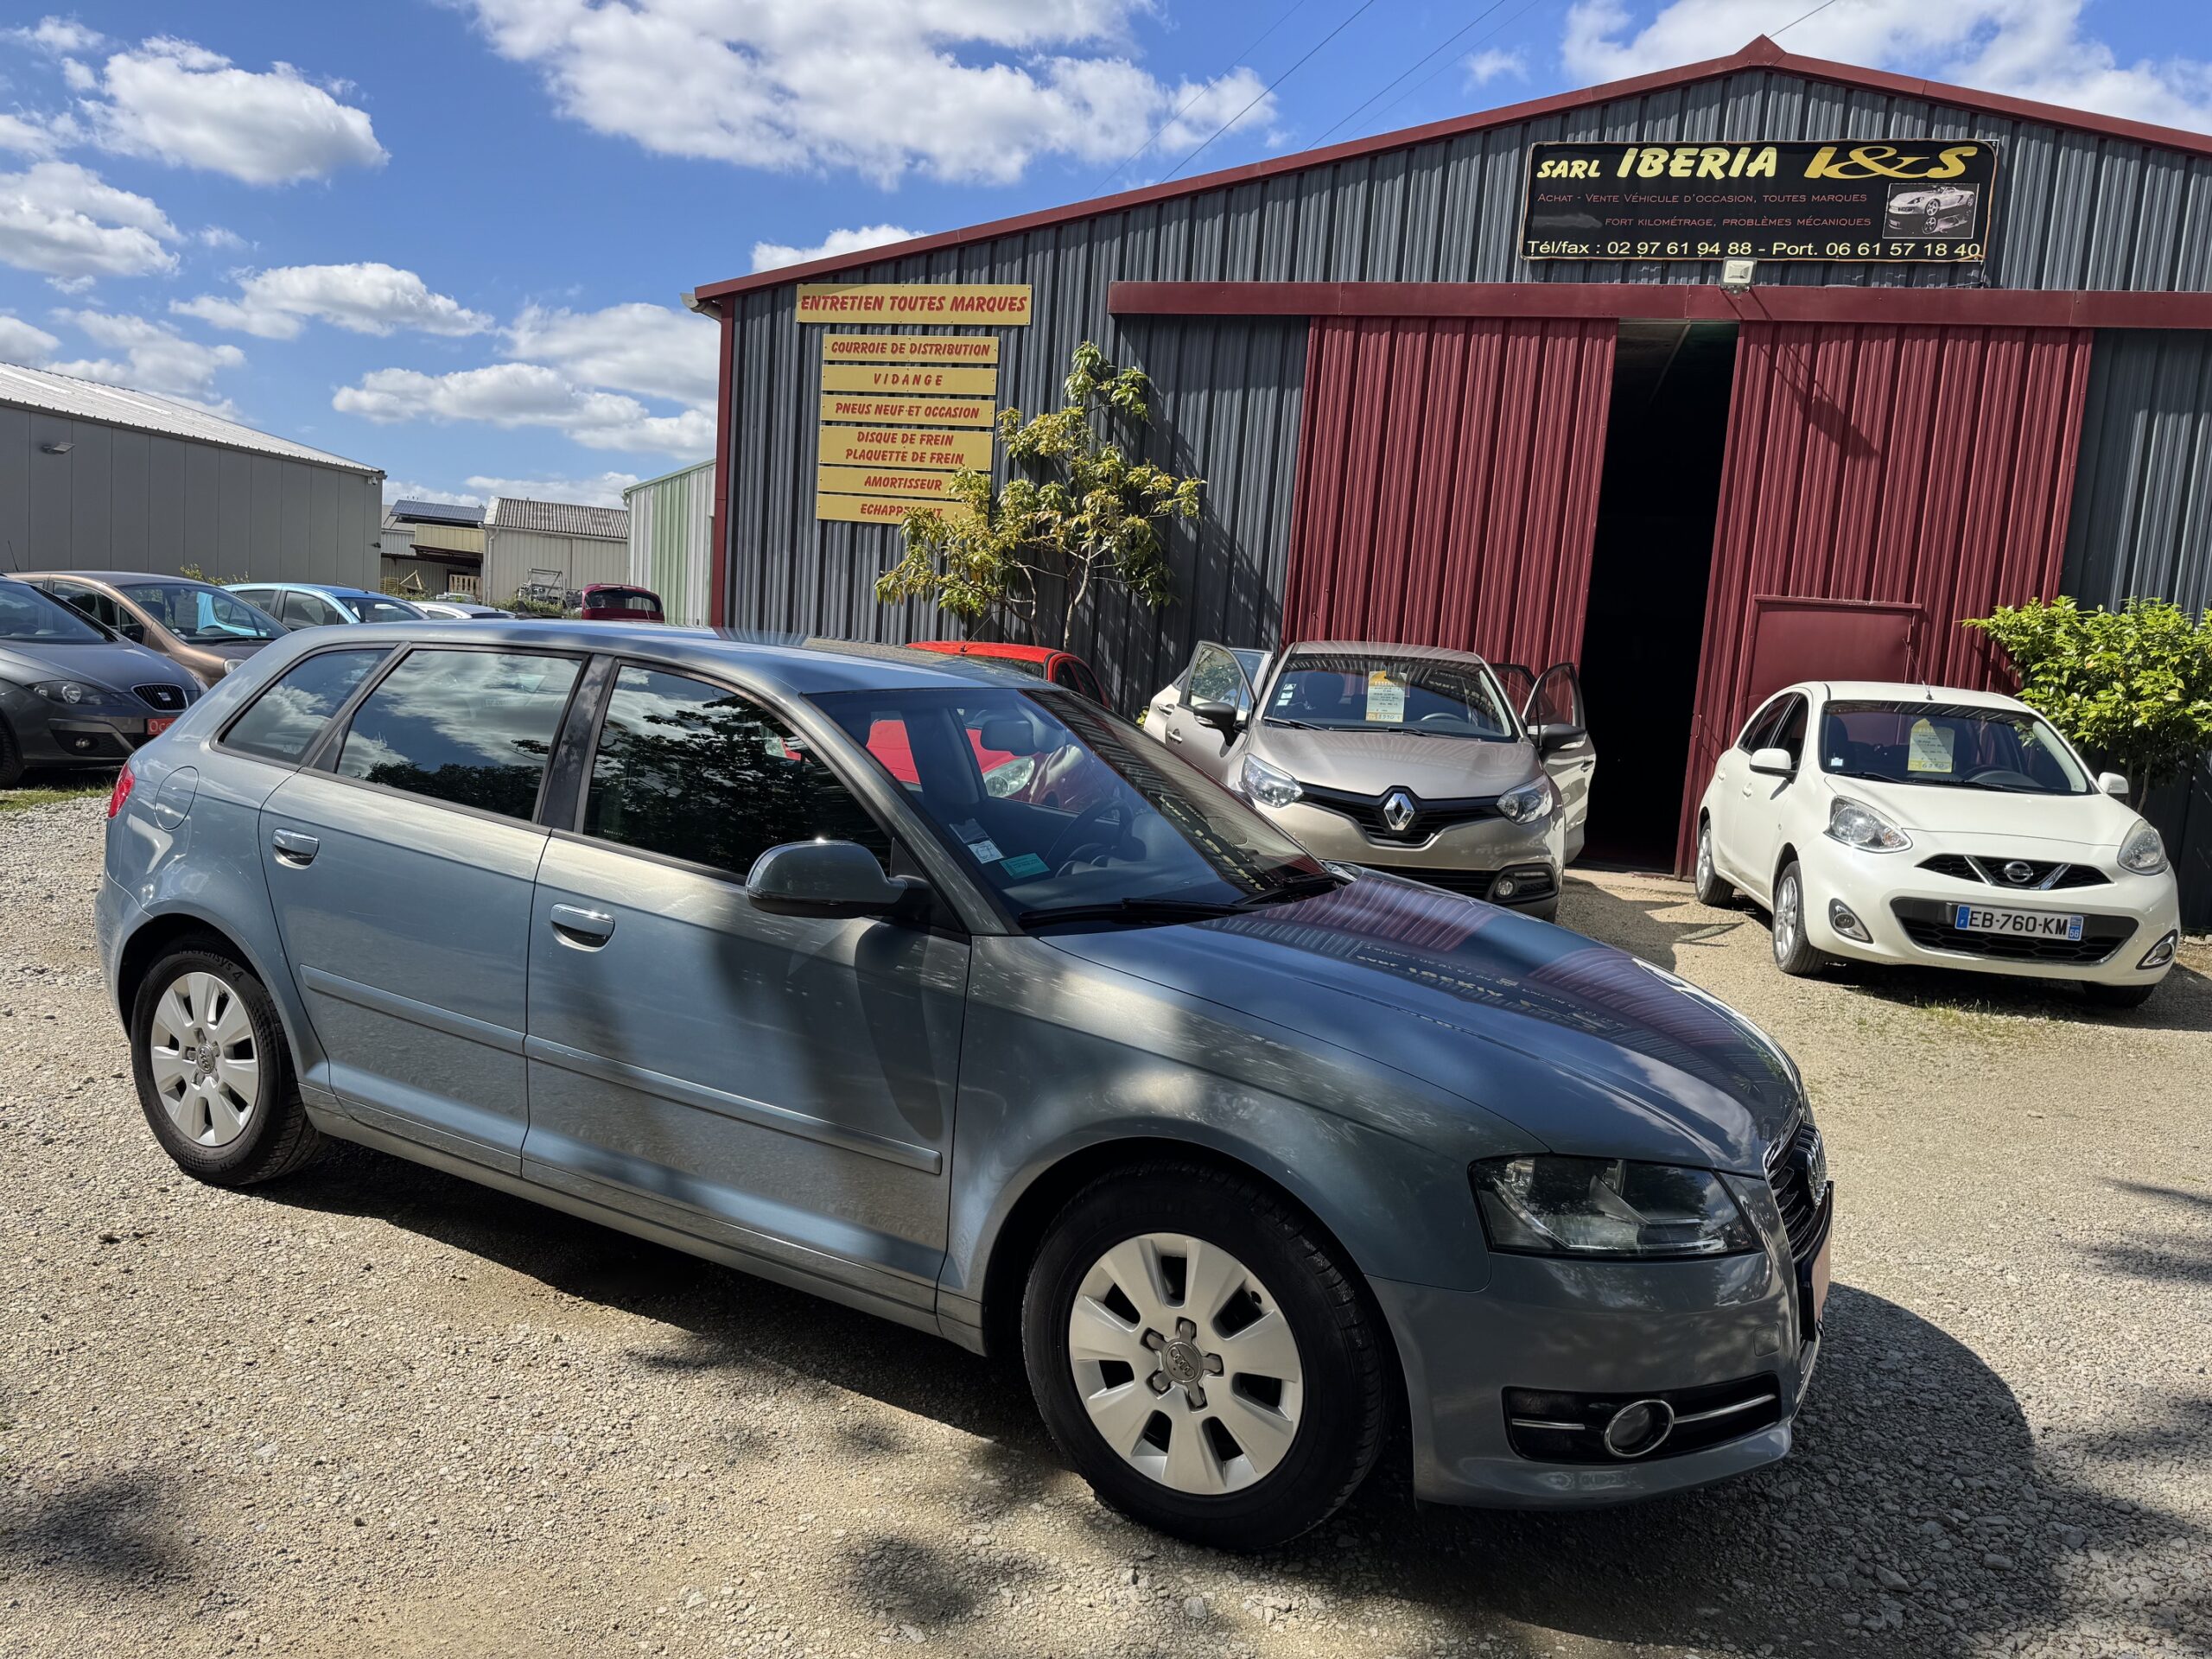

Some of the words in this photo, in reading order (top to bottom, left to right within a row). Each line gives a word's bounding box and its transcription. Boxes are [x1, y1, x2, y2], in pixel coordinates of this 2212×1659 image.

[1536, 160, 1601, 179] SARL
[1617, 147, 1777, 180] IBERIA
[1803, 145, 1978, 179] I&S
[1537, 194, 1573, 202] ACHAT
[1586, 194, 1619, 203] VENTE
[1624, 192, 1679, 203] VÉHICULE
[1605, 218, 1634, 226] FORT
[1637, 216, 1717, 227] KILOMÉTRAGE,
[1722, 215, 1792, 226] PROBLÈMES
[1796, 215, 1872, 226] MÉCANIQUES
[1527, 240, 1590, 254] Tél/fax
[1607, 241, 1630, 254] 02
[1637, 242, 1661, 254] 97
[1666, 242, 1688, 255] 61
[1697, 242, 1720, 255] 94
[1727, 242, 1751, 255] 88
[1772, 242, 1818, 256] Port.
[1826, 242, 1851, 256] 06
[1858, 242, 1880, 256] 61
[1890, 243, 1916, 256] 57
[1923, 243, 1948, 256] 18
[1954, 243, 1980, 257] 40
[801, 296, 885, 311] ENTRETIEN
[889, 296, 946, 312] TOUTES
[950, 296, 1027, 313] MARQUES
[831, 341, 887, 354] COURROIE
[891, 342, 906, 354] DE
[909, 343, 990, 356] DISTRIBUTION
[873, 373, 944, 387] VIDANGE
[836, 403, 872, 415] PNEUS
[874, 404, 905, 416] NEUF
[907, 405, 922, 416] ET
[924, 406, 980, 418] OCCASION
[857, 431, 898, 444] DISQUE
[900, 433, 916, 445] DE
[919, 434, 954, 446] FREIN
[845, 448, 908, 462] PLAQUETTE
[911, 451, 926, 463] DE
[930, 452, 964, 464] FREIN
[864, 475, 943, 491] AMORTISSEUR
[1968, 911, 2068, 936] EB-760-KM
[2069, 927, 2079, 938] 56
